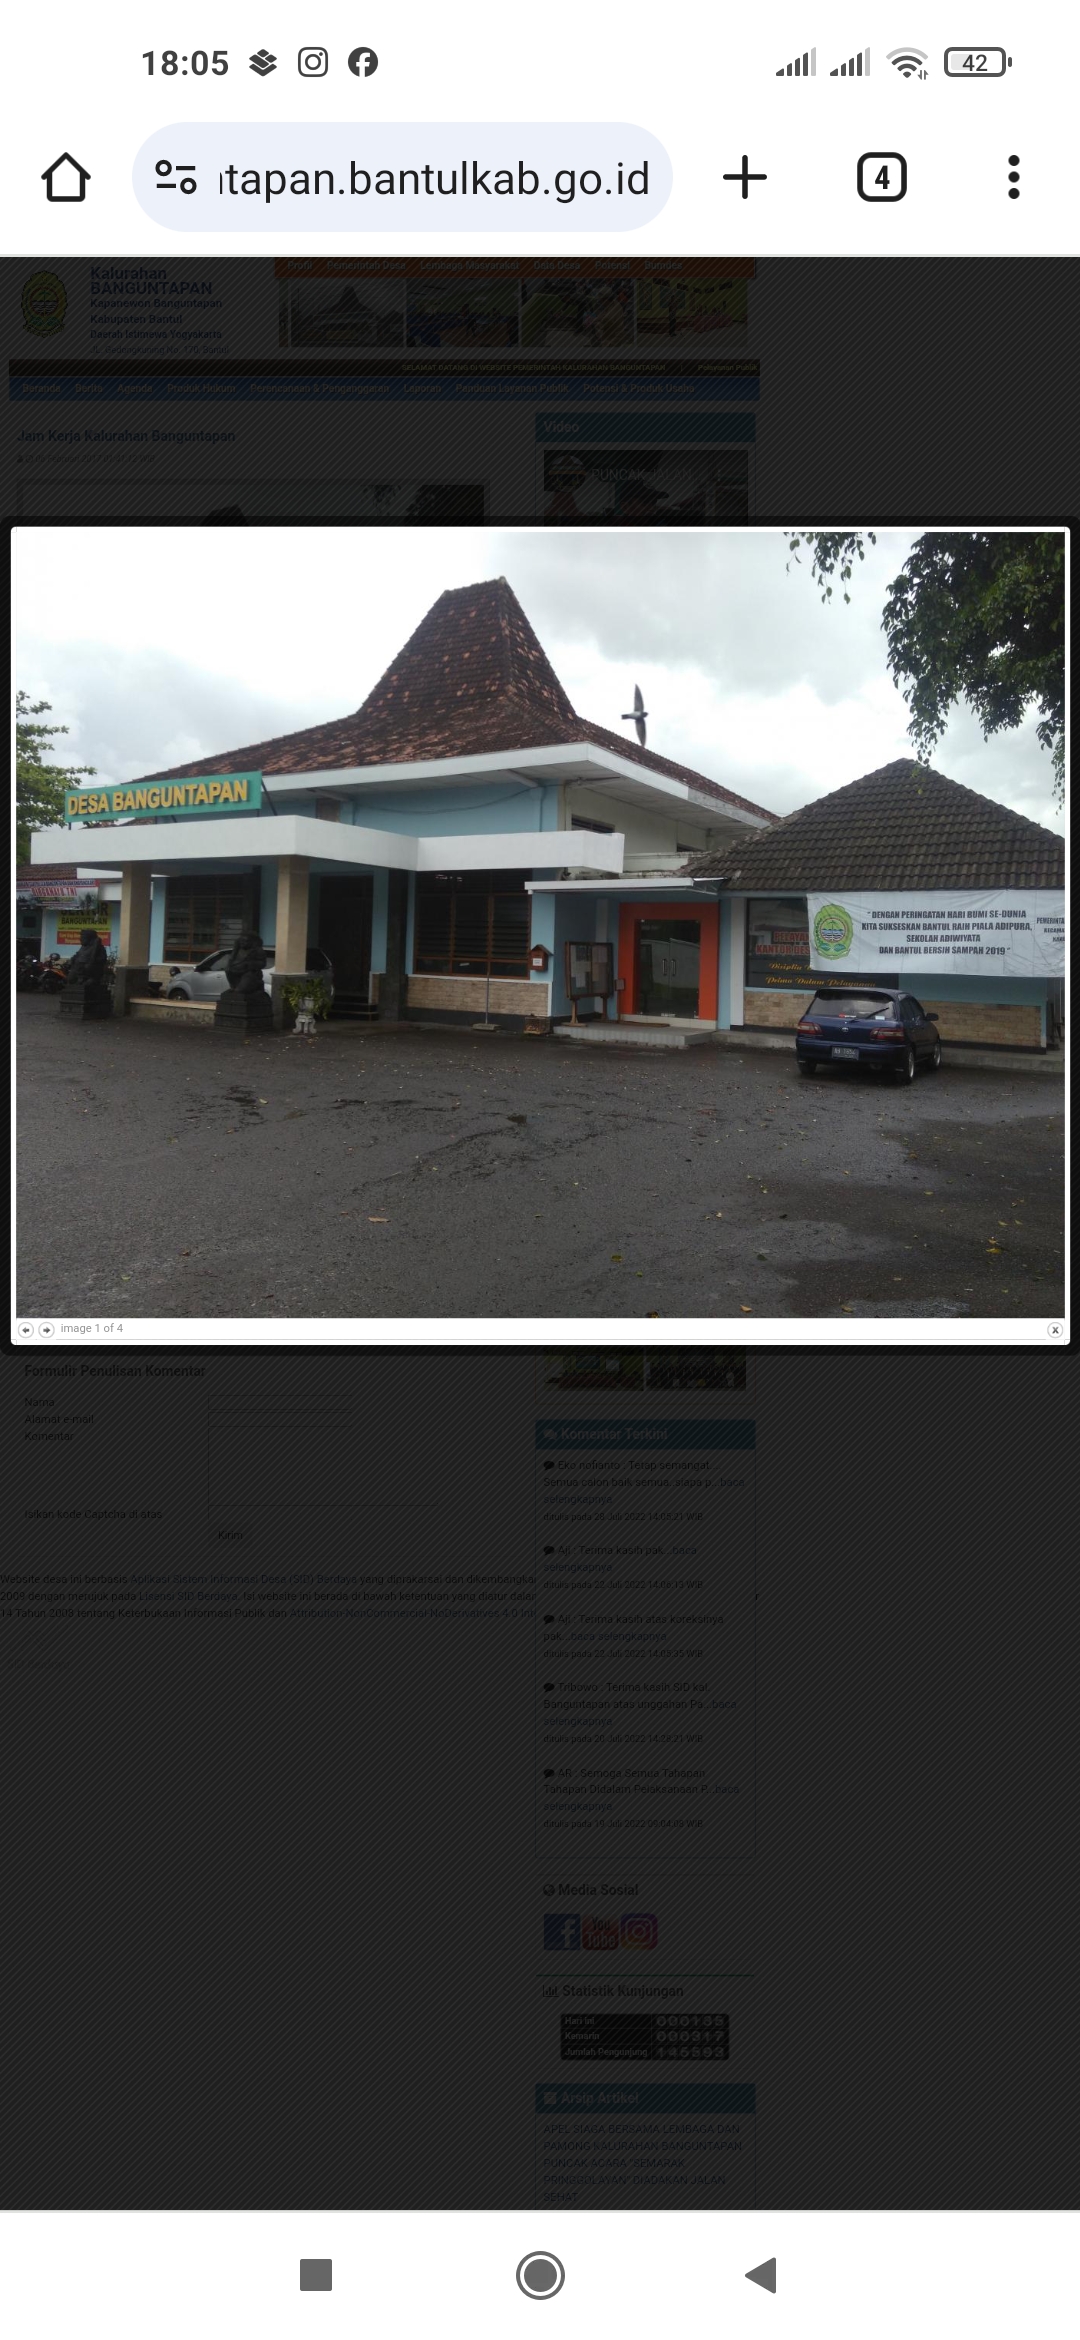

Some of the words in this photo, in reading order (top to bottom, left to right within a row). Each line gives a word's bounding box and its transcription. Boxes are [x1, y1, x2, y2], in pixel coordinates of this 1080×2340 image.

[142, 50, 229, 76] 18:05
[962, 53, 988, 72] 42
[875, 166, 890, 190] 4
[287, 260, 313, 270] Profil
[326, 260, 381, 270] Pemerintah
[382, 260, 406, 270] Desa
[420, 260, 463, 272] Lembaga
[465, 260, 520, 272] Masyarakat
[533, 260, 555, 270] Data
[557, 260, 581, 270] Desa
[594, 260, 631, 270] Potensi
[644, 260, 683, 270] Bumdes
[90, 266, 167, 280] Kalurahan
[90, 281, 212, 295] BANGUNTAPAN
[90, 298, 151, 310] Kapanewon
[153, 298, 223, 310] Banguntapan
[90, 314, 146, 326] Kabupaten
[149, 314, 183, 324] Bantul
[90, 329, 123, 339] Daerah
[125, 329, 168, 339] Istimewa
[169, 329, 222, 341] Yogyakarta
[22, 383, 61, 393] Beranda
[75, 383, 103, 393] Berita
[116, 383, 153, 395] Agenda
[167, 383, 201, 393] Produk
[202, 383, 236, 393] Hukum
[250, 383, 311, 393] Perencanaan
[322, 383, 390, 395] Penganggaran
[403, 383, 442, 395] Laporan
[455, 383, 497, 393] Panduan
[498, 383, 538, 395] Layanan
[539, 383, 569, 393] Publik
[583, 383, 619, 393] Potensi
[630, 383, 664, 393] Produk
[665, 383, 695, 393] Usaha
[542, 420, 580, 433] Video
[16, 429, 45, 442] Jam
[48, 429, 81, 445] Kerja
[84, 429, 149, 442] Kalurahan
[151, 429, 236, 445] Banguntapan
[68, 792, 109, 815] DESA
[112, 780, 248, 811] BANGUNTAPAN
[901, 910, 945, 919] PERINGATAN
[947, 910, 965, 919] HARI
[966, 910, 987, 919] BUMI
[989, 910, 1027, 918] SE-DUNIA
[61, 917, 108, 925] BANGUNTAPAN
[861, 923, 878, 931] KITA
[878, 922, 921, 931] SUKSESKAN
[922, 922, 950, 931] BANTUL
[952, 922, 970, 931] RAIH
[971, 922, 994, 931] PIALA
[995, 922, 1033, 931] ADIPURA,
[906, 934, 938, 943] SEKOLAH
[939, 934, 981, 942] ADIWIYATA
[756, 944, 792, 955] KANTOR
[879, 946, 894, 954] DAN
[894, 946, 922, 954] BANTUL
[923, 946, 950, 954] BERSIH
[951, 946, 984, 954] SAMPAH
[60, 1323, 92, 1335] image
[103, 1322, 115, 1333] of
[116, 1323, 124, 1333] 4
[24, 1364, 78, 1377] Formulir
[80, 1364, 142, 1377] Penulisan
[145, 1364, 207, 1377] Komentar
[24, 1397, 55, 1407] Nama
[24, 1431, 74, 1441] Komentar
[561, 1427, 622, 1440] Komentar
[623, 1427, 668, 1440] Terkini
[24, 1509, 54, 1519] Isikan
[57, 1509, 82, 1519] kode
[84, 1509, 126, 1521] Captcha
[128, 1509, 138, 1519] di
[140, 1510, 163, 1519] atas
[218, 1530, 243, 1540] Kirim
[558, 1883, 597, 1896] Media
[600, 1883, 639, 1896] Sosial
[562, 1984, 615, 1997] Statistik
[617, 1984, 684, 2000] Kunjungan
[564, 2016, 583, 2025] Hari
[584, 2016, 595, 2025] ini
[564, 2031, 600, 2040] Kemarin
[564, 2047, 596, 2056] Jumlah
[597, 2047, 648, 2058] Pengunjung
[560, 2091, 594, 2107] Arsip
[596, 2091, 639, 2104] Artikel
